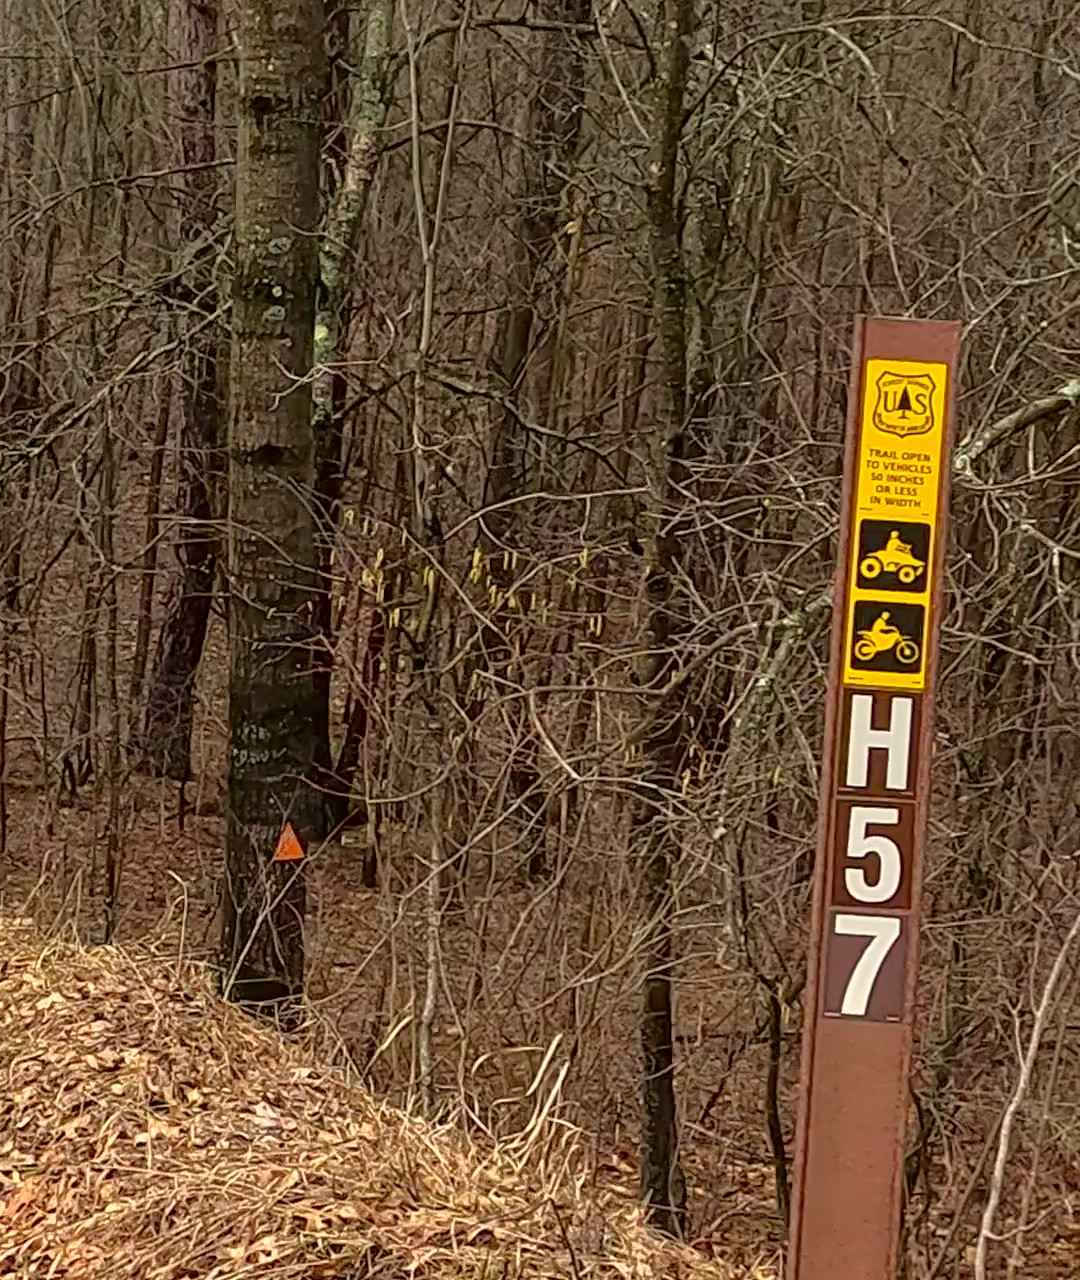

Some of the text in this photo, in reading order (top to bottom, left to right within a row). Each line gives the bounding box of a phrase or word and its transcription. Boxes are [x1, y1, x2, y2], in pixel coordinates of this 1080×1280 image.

[869, 448, 930, 462] TRAIL OPEN
[866, 459, 932, 474] TO VEHICLES
[871, 471, 924, 485] 50 INCHES
[875, 484, 917, 496] OR LESS
[870, 495, 921, 507] IN WIDTH
